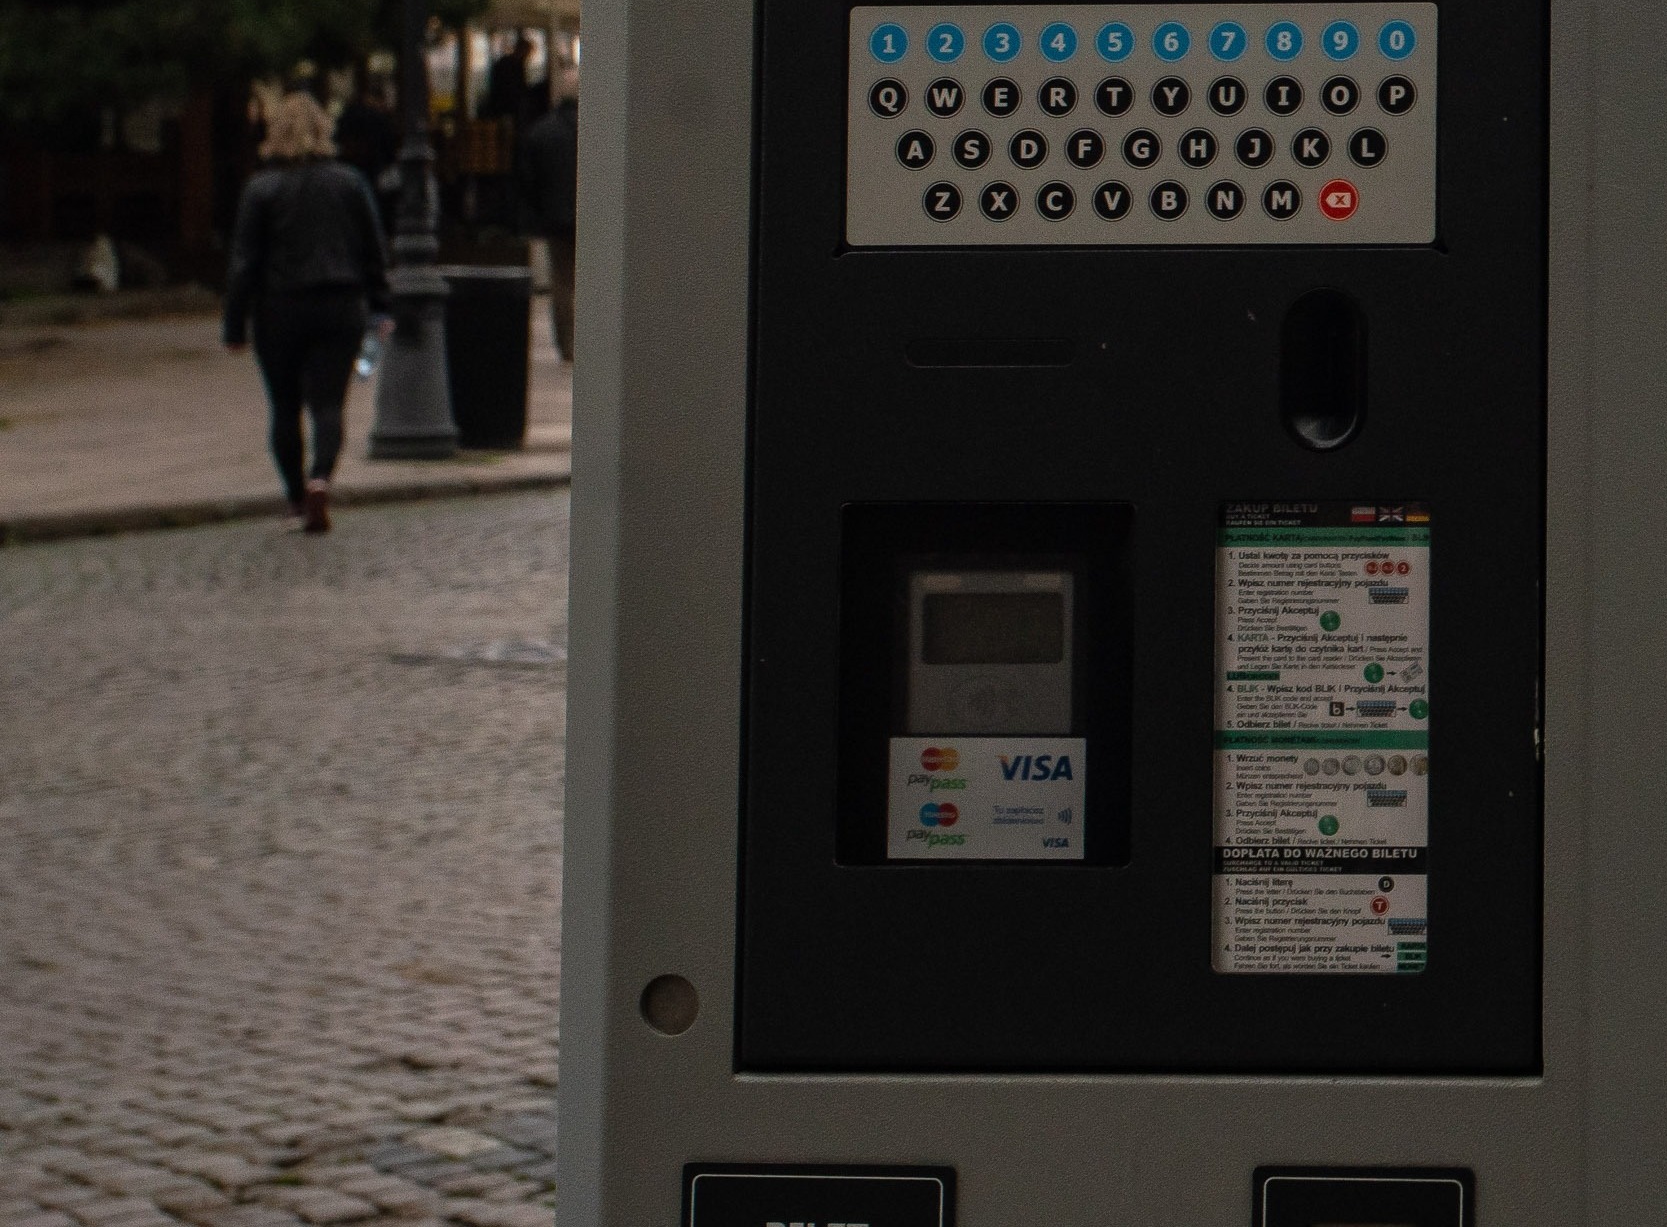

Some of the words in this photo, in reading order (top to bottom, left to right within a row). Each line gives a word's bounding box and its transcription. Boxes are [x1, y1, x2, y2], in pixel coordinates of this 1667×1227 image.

[883, 34, 896, 54] 1
[939, 33, 953, 54] 2
[995, 32, 1010, 53] 3
[1050, 32, 1066, 52] 4
[1108, 32, 1123, 52] 5
[1163, 31, 1179, 52] 6
[1221, 31, 1236, 52] 7
[1276, 31, 1292, 52] 8
[1333, 30, 1349, 51] 9
[1389, 29, 1405, 51] 0
[878, 87, 898, 113] Q
[932, 88, 958, 108] W
[994, 87, 1008, 108] E
[1050, 87, 1067, 107] R
[1106, 86, 1123, 107] T
[1162, 86, 1180, 107] Y
[1218, 86, 1236, 107] U
[1278, 85, 1290, 106] I
[1330, 85, 1350, 106] O
[1389, 85, 1406, 105] P
[906, 140, 924, 160] A
[964, 139, 980, 160] S
[1020, 139, 1038, 159] D
[1078, 138, 1092, 159] F
[1132, 138, 1150, 159] G
[1189, 138, 1207, 159] H
[1248, 138, 1261, 159] J
[1303, 138, 1320, 158] K
[1361, 137, 1375, 158] L
[934, 191, 951, 212] Z
[990, 191, 1008, 211] X
[1046, 190, 1063, 212] C
[1103, 190, 1122, 211] V
[1161, 190, 1178, 211] B
[1216, 190, 1234, 210] N
[1271, 190, 1292, 210] M
[996, 755, 1073, 781] VISA
[1043, 838, 1069, 848] VISA
[1223, 849, 1279, 858] DOPŁATA
[1284, 848, 1302, 858] DO
[1304, 847, 1368, 858] WAŻNEGO
[1372, 848, 1418, 858] BILETU
